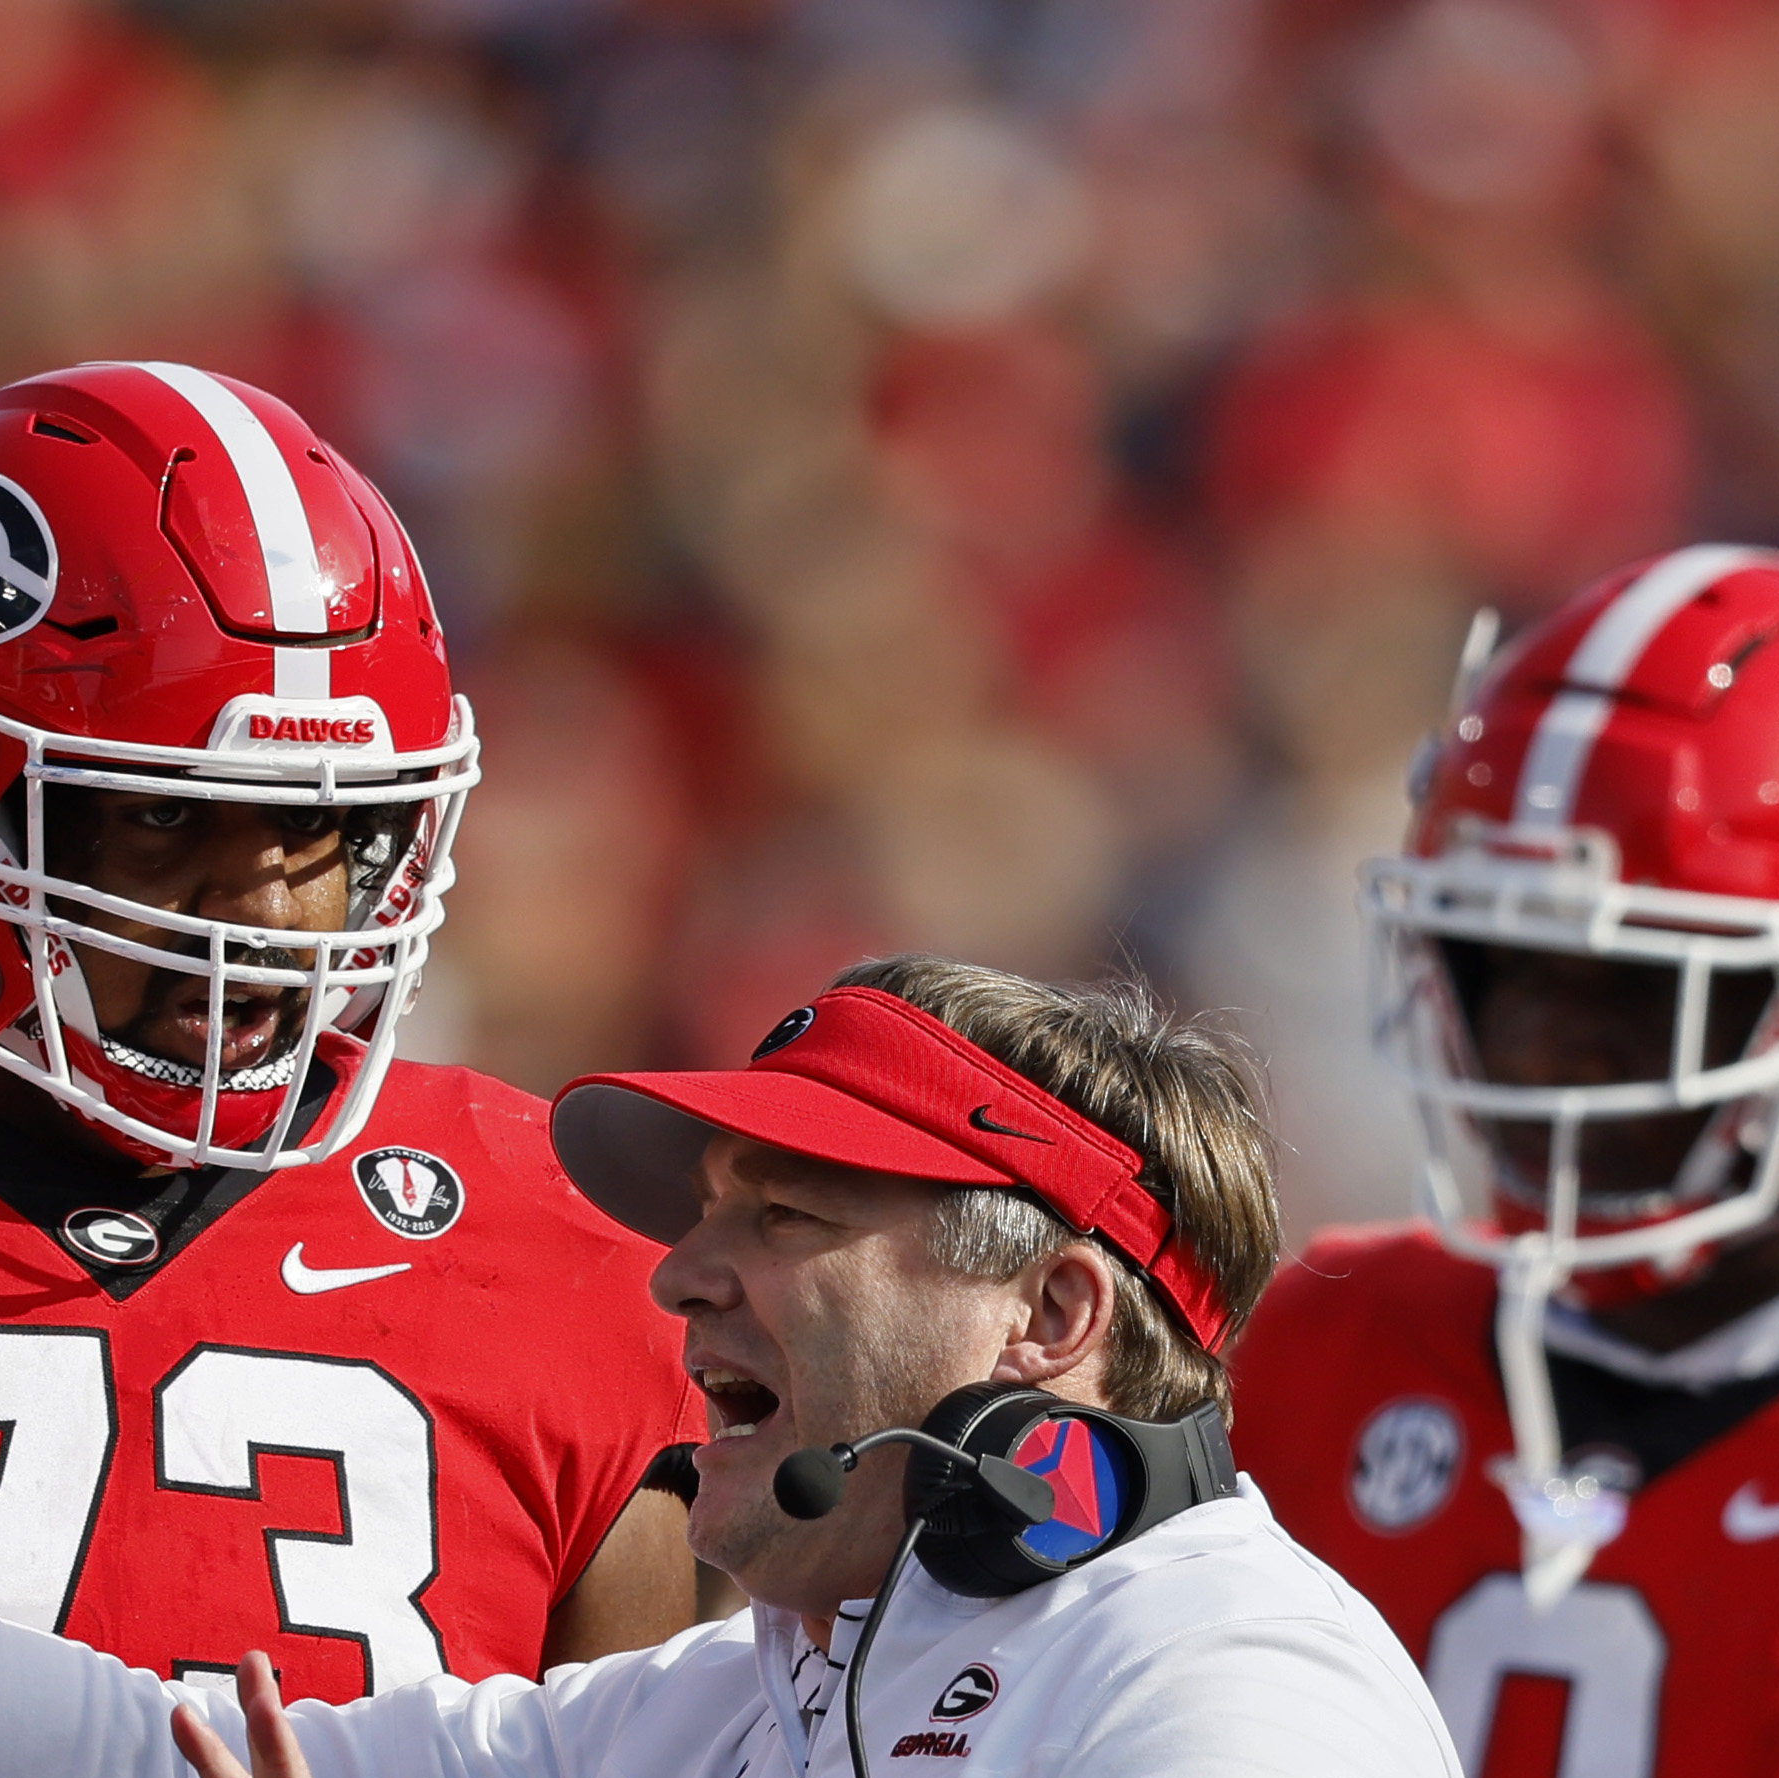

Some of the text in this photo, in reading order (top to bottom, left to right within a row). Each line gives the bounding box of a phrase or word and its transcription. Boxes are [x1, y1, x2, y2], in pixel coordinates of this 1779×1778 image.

[248, 714, 375, 743] DAWGS
[63, 1207, 158, 1264] G
[385, 1210, 436, 1232] 1932-2022
[931, 1665, 995, 1718] G
